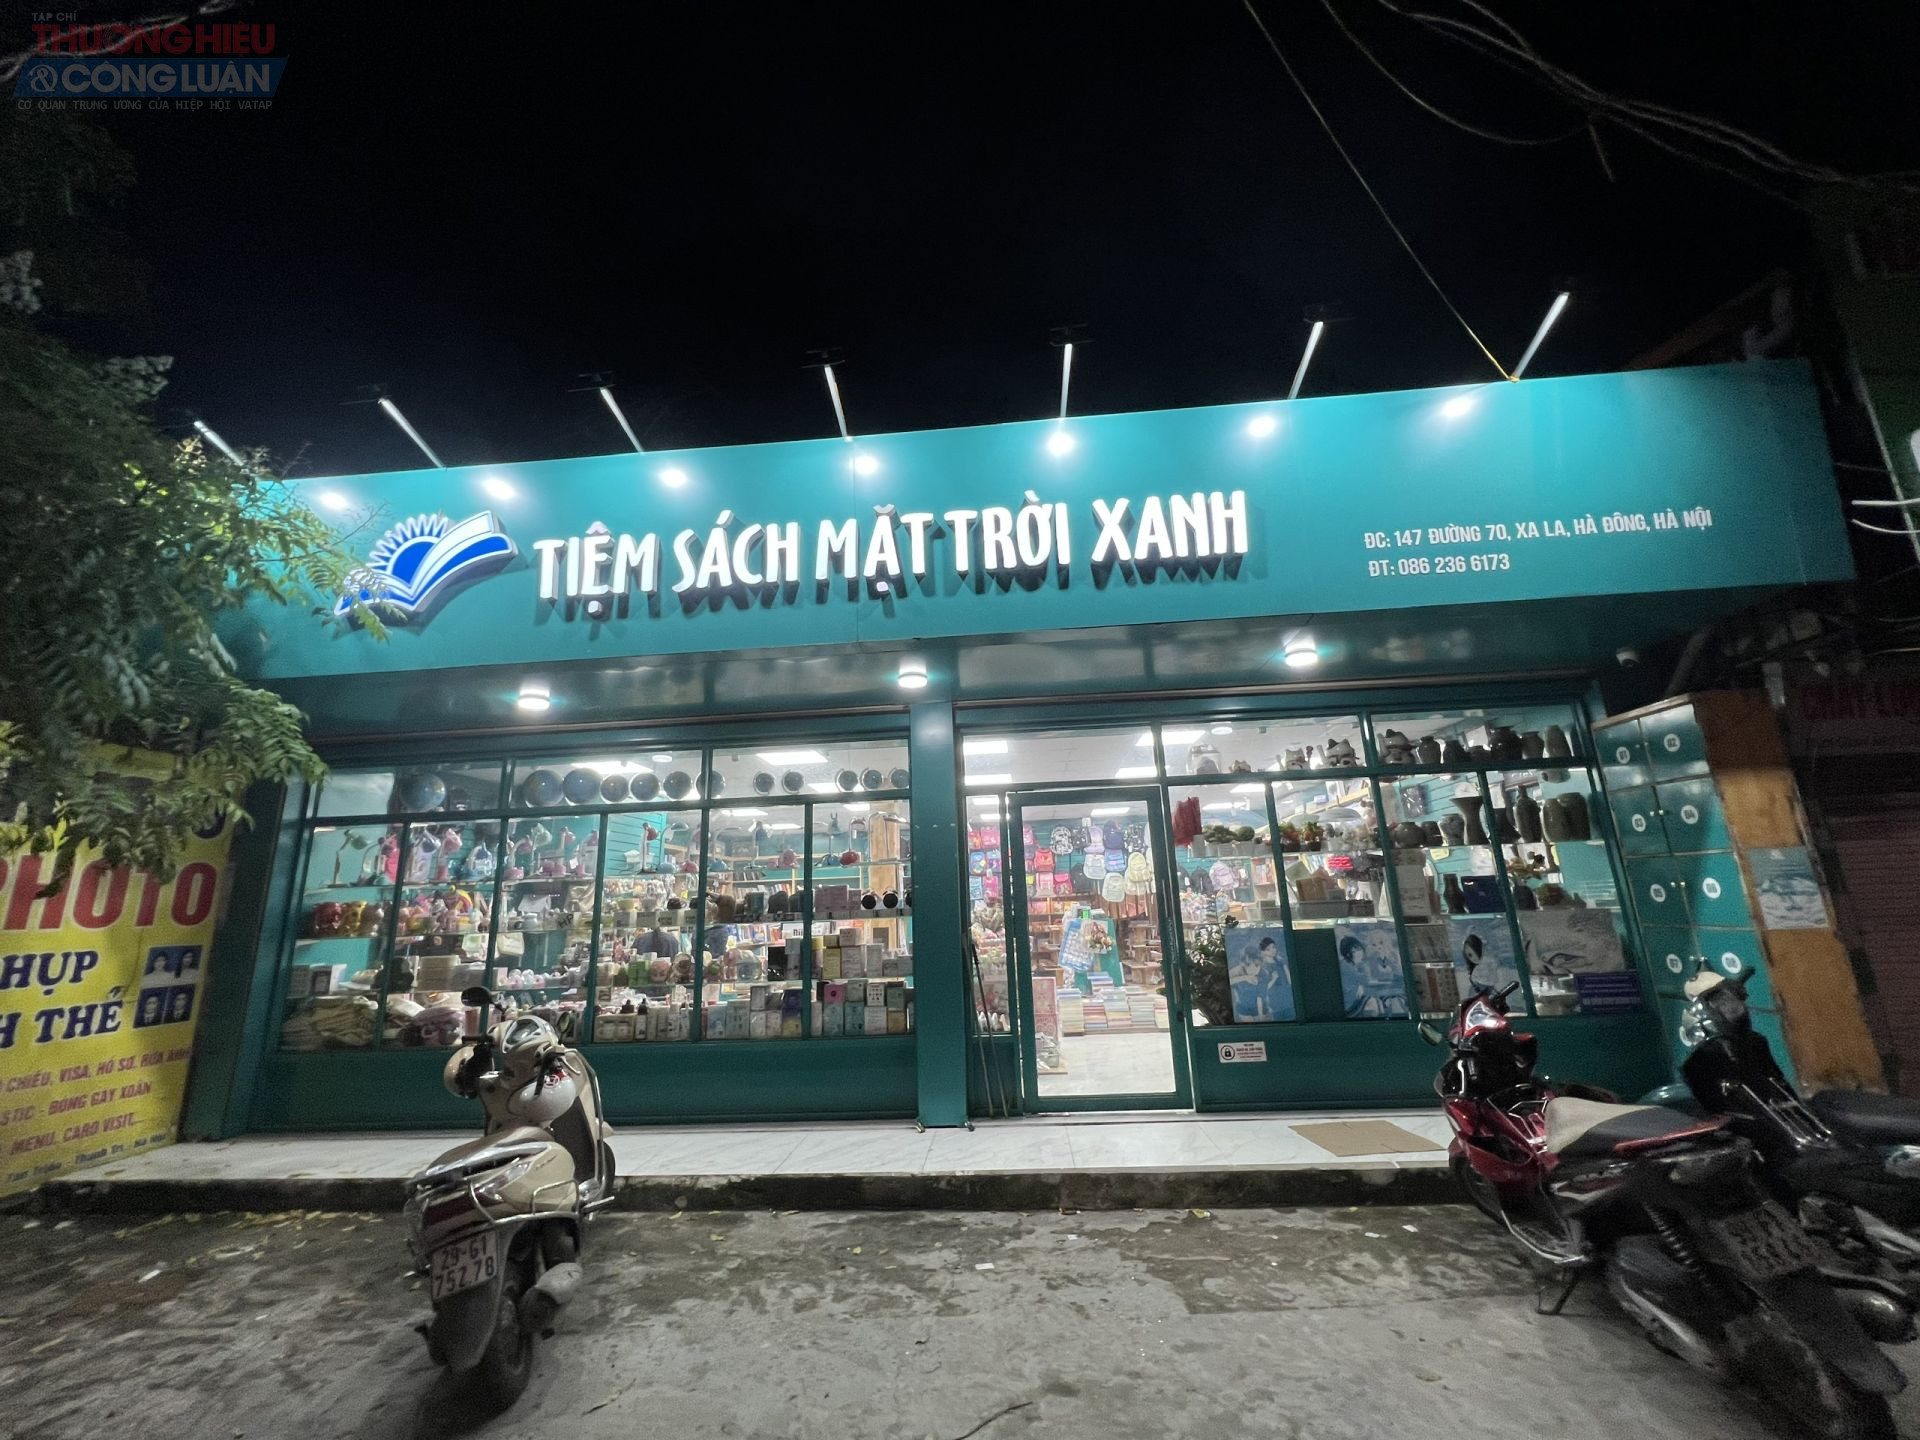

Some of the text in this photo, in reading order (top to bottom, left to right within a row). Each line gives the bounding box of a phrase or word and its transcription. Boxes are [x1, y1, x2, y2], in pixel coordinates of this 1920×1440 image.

[534, 490, 1248, 613] TIỆM SÁCH MẶT TRỜI XANH
[1364, 532, 1391, 549] ĐC:
[1394, 530, 1422, 547] 147
[1485, 524, 1512, 541] 70,
[1515, 522, 1540, 538] XA
[1544, 520, 1571, 538] LA,
[1573, 513, 1598, 535] HÀ
[1653, 508, 1679, 530] HÀ
[1683, 506, 1713, 531] NỘI
[1368, 553, 1510, 577] ĐT: 086 236 6173
[0, 853, 217, 930] HOTO
